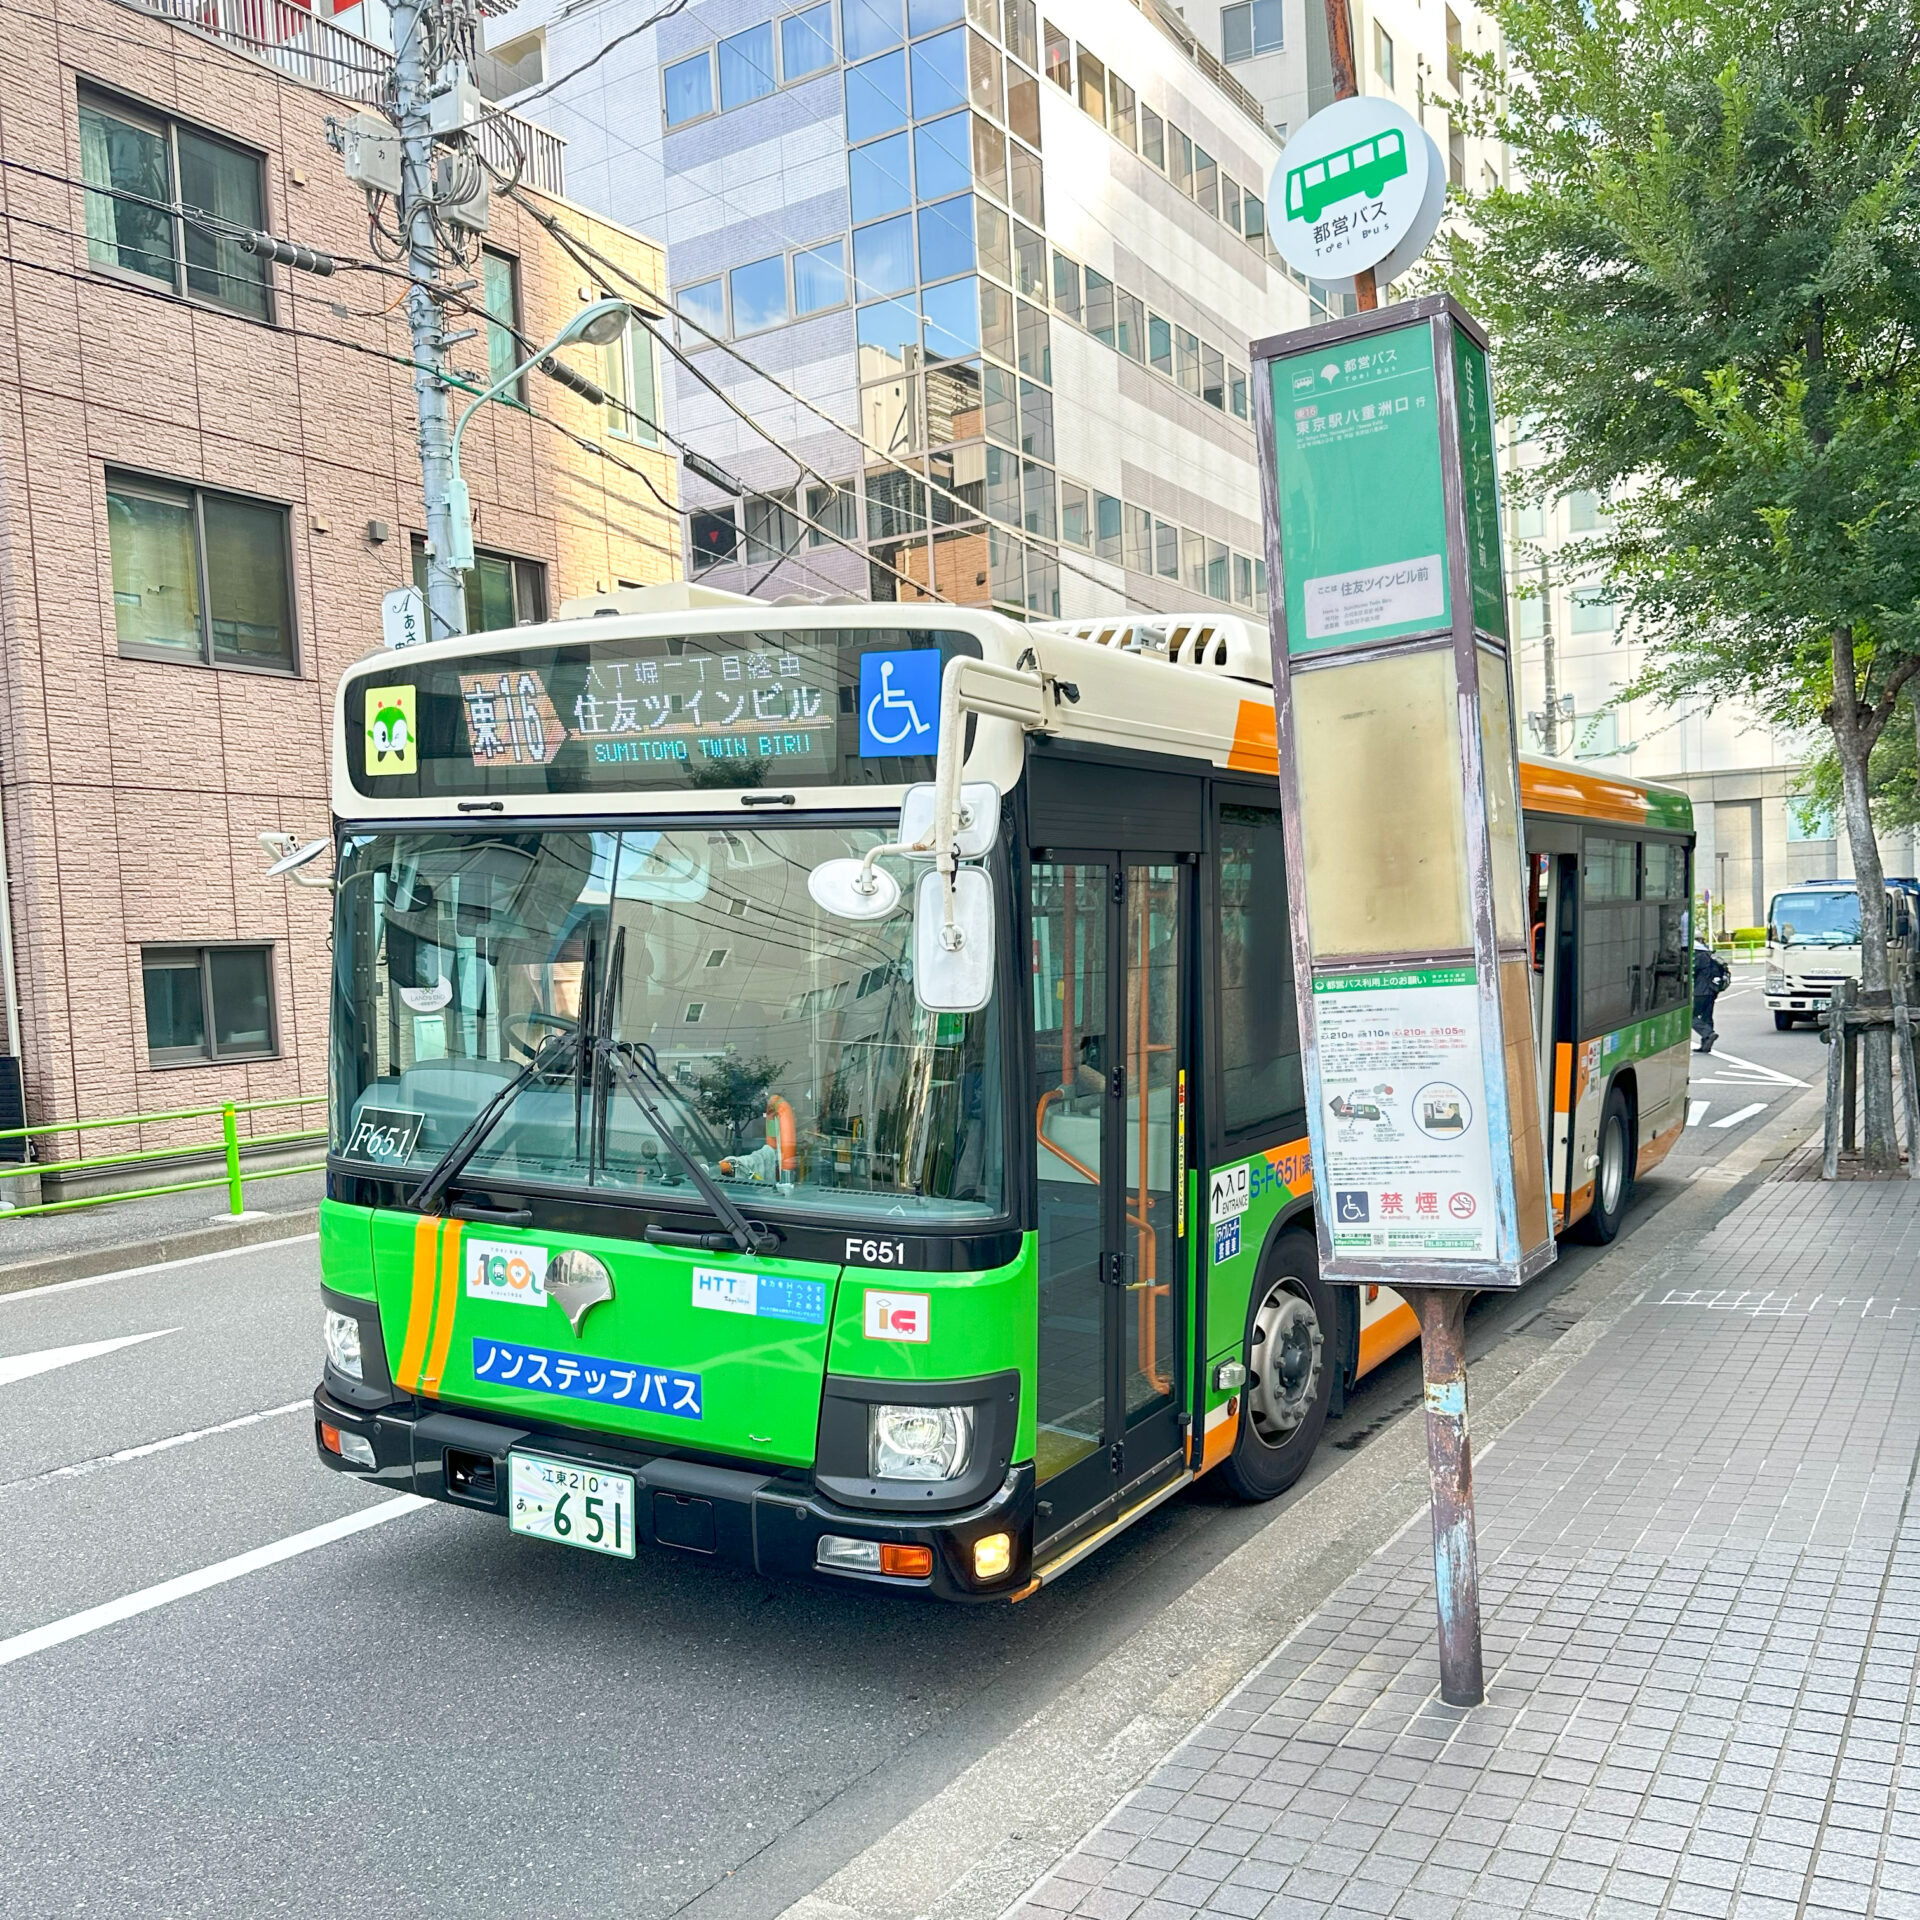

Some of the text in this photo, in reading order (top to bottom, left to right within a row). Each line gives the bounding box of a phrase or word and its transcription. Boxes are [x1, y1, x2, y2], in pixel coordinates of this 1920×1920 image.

[1313, 201, 1387, 244] 都営バス
[1315, 223, 1389, 257] Toei Bus
[1344, 350, 1398, 374] 都営バス
[1296, 397, 1409, 436] 東京駅八重洲口
[1415, 396, 1426, 408] 行
[1318, 567, 1429, 597] ここは 住友ツインビル前
[573, 682, 822, 735] 住友ツインビル
[594, 734, 811, 763] SUMITOMO TWIN BIRU
[1326, 975, 1427, 990] 都営バス利用上のお願い
[351, 1122, 411, 1158] F651
[1226, 1169, 1246, 1198] 入口
[1222, 1194, 1248, 1215] ENTRANCE
[846, 1238, 904, 1265] F651
[700, 1275, 737, 1294] HTT
[476, 1346, 700, 1414] ノンステップバス
[542, 1469, 599, 1493] 江東210
[516, 1498, 527, 1512] あ
